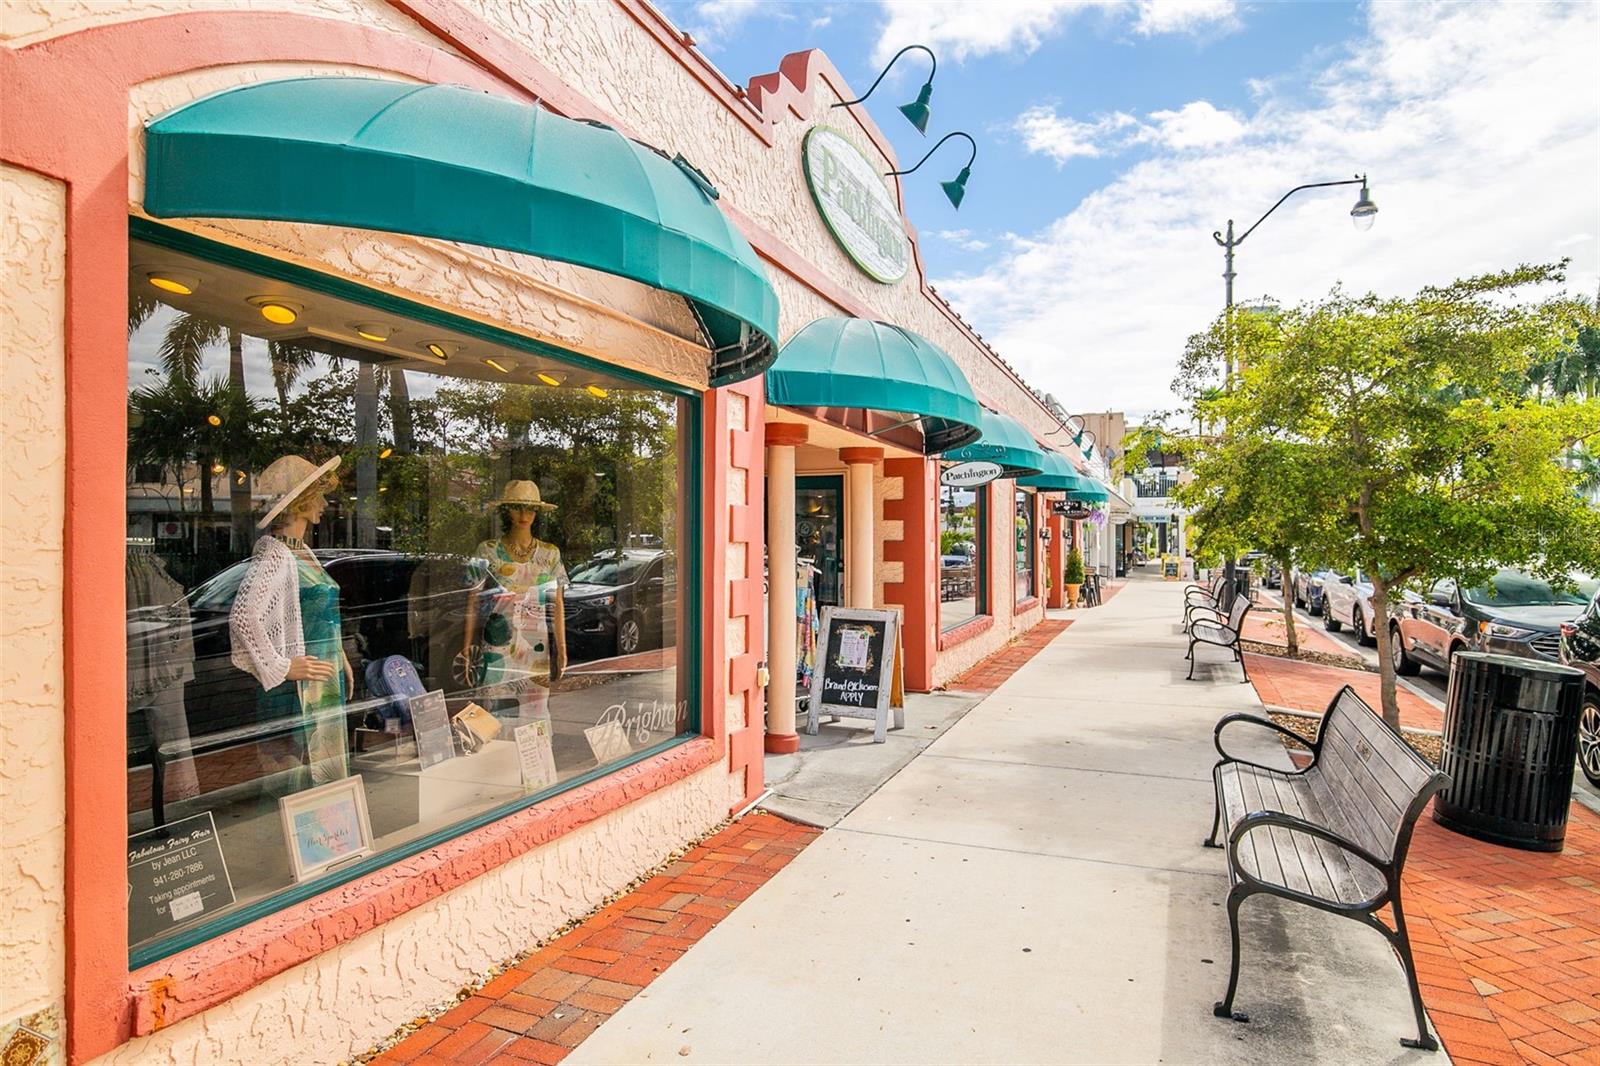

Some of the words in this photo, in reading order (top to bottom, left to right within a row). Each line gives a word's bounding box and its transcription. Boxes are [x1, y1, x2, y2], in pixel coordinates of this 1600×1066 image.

[945, 468, 997, 481] Patchington
[824, 677, 847, 690] Brand
[593, 699, 688, 752] Brighton
[128, 844, 165, 862] Fabulous
[166, 837, 190, 849] Fairy
[191, 829, 211, 840] Hair
[151, 859, 162, 871] by
[162, 853, 181, 867] Jean
[181, 846, 197, 860] LLC
[148, 890, 173, 905] Taking
[173, 873, 216, 898] appointments
[155, 906, 167, 916] for
